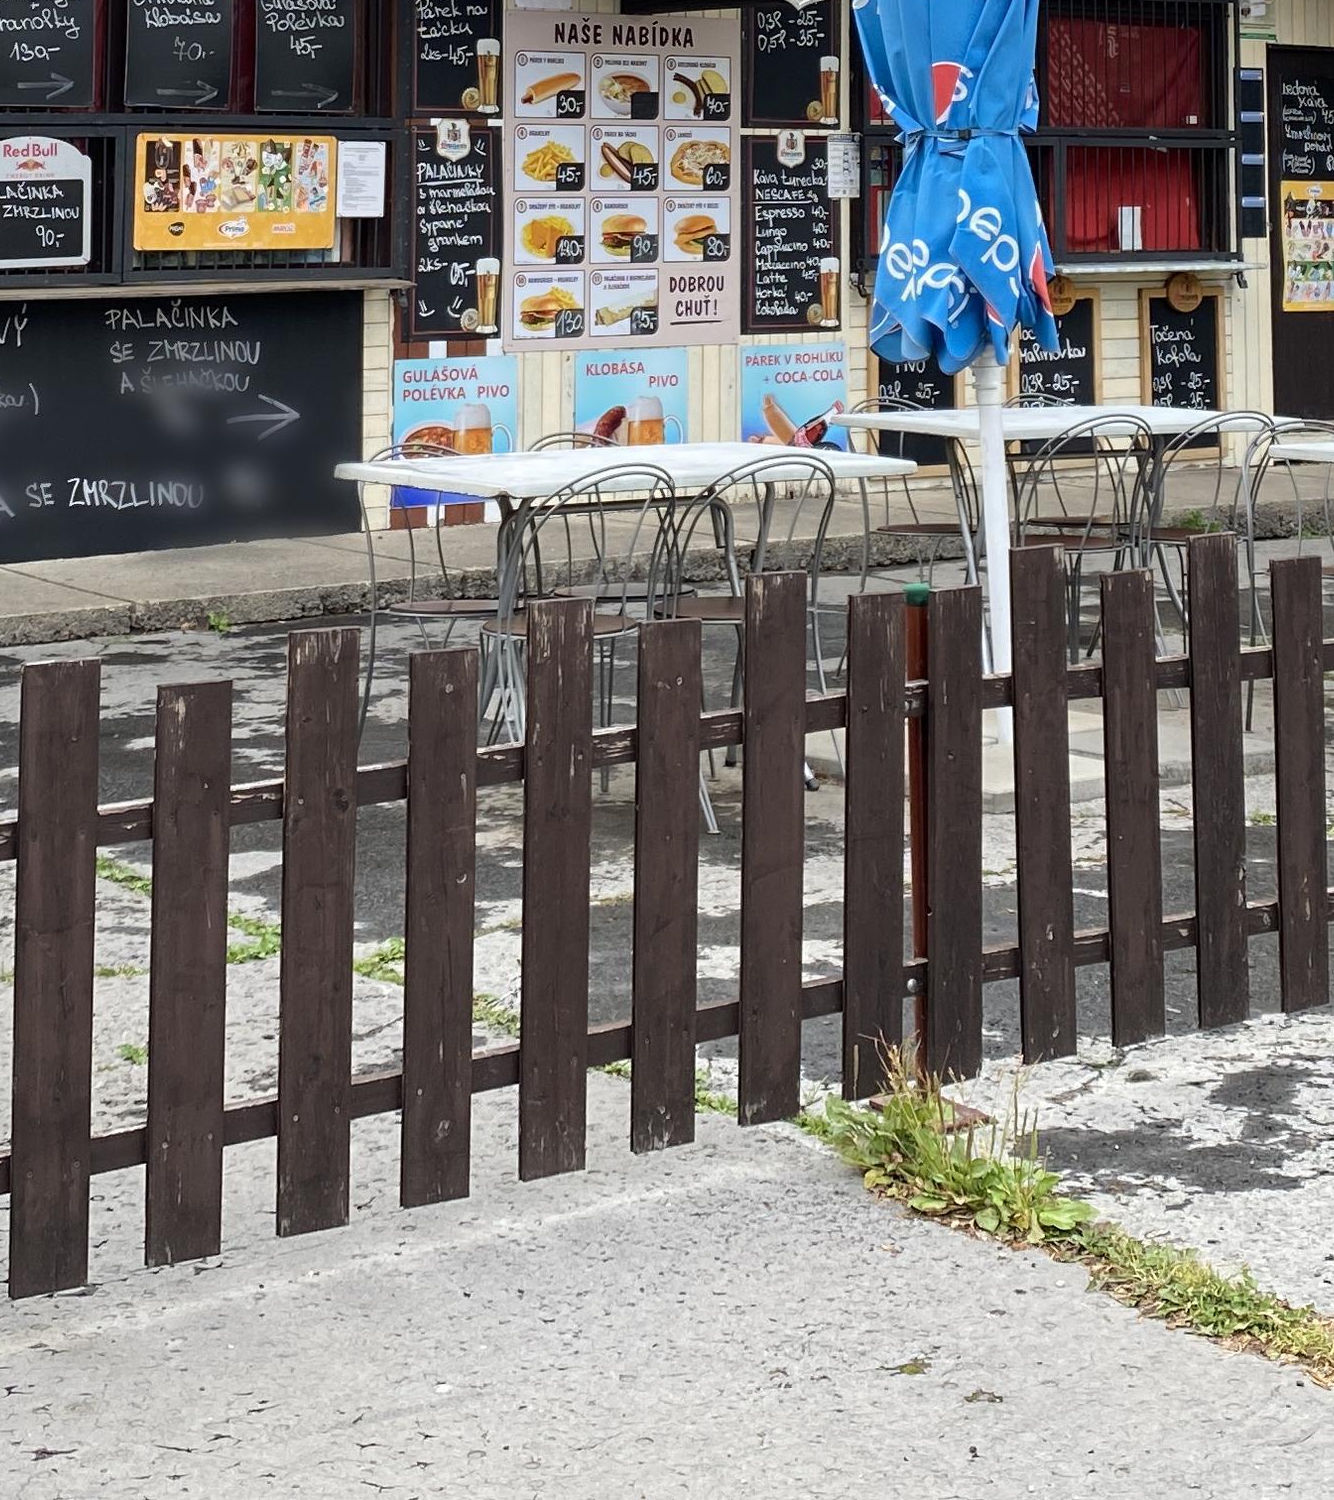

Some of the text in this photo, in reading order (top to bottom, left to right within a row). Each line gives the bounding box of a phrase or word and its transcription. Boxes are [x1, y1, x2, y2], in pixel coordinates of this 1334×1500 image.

[466, 3, 488, 16] na
[554, 18, 694, 48] NAŠE NABÍDKA
[3, 143, 58, 157] Red Bull
[417, 161, 484, 182] PALAČINKY
[2, 205, 80, 220] ZMRZLINOU
[755, 206, 805, 227] Espresso
[756, 225, 787, 240] Lungo
[669, 275, 724, 293] DOBROU
[756, 273, 788, 284] Latte
[105, 298, 238, 330] PALAČINKA
[109, 339, 261, 365] SE ZMRZLINOU
[745, 349, 843, 367] PÁREK V ROHLÍKU
[1157, 344, 1202, 368] Kofola
[402, 364, 478, 383] GULÁŠOVÁ
[585, 360, 645, 377] KLOBÁSA
[774, 368, 844, 384] COCA-COLA
[120, 372, 135, 394] A
[648, 375, 678, 388] PIVO
[402, 384, 509, 402] POLÉVKA PIVO
[26, 483, 52, 508] SE
[67, 478, 204, 510] ZMRZLINOU
